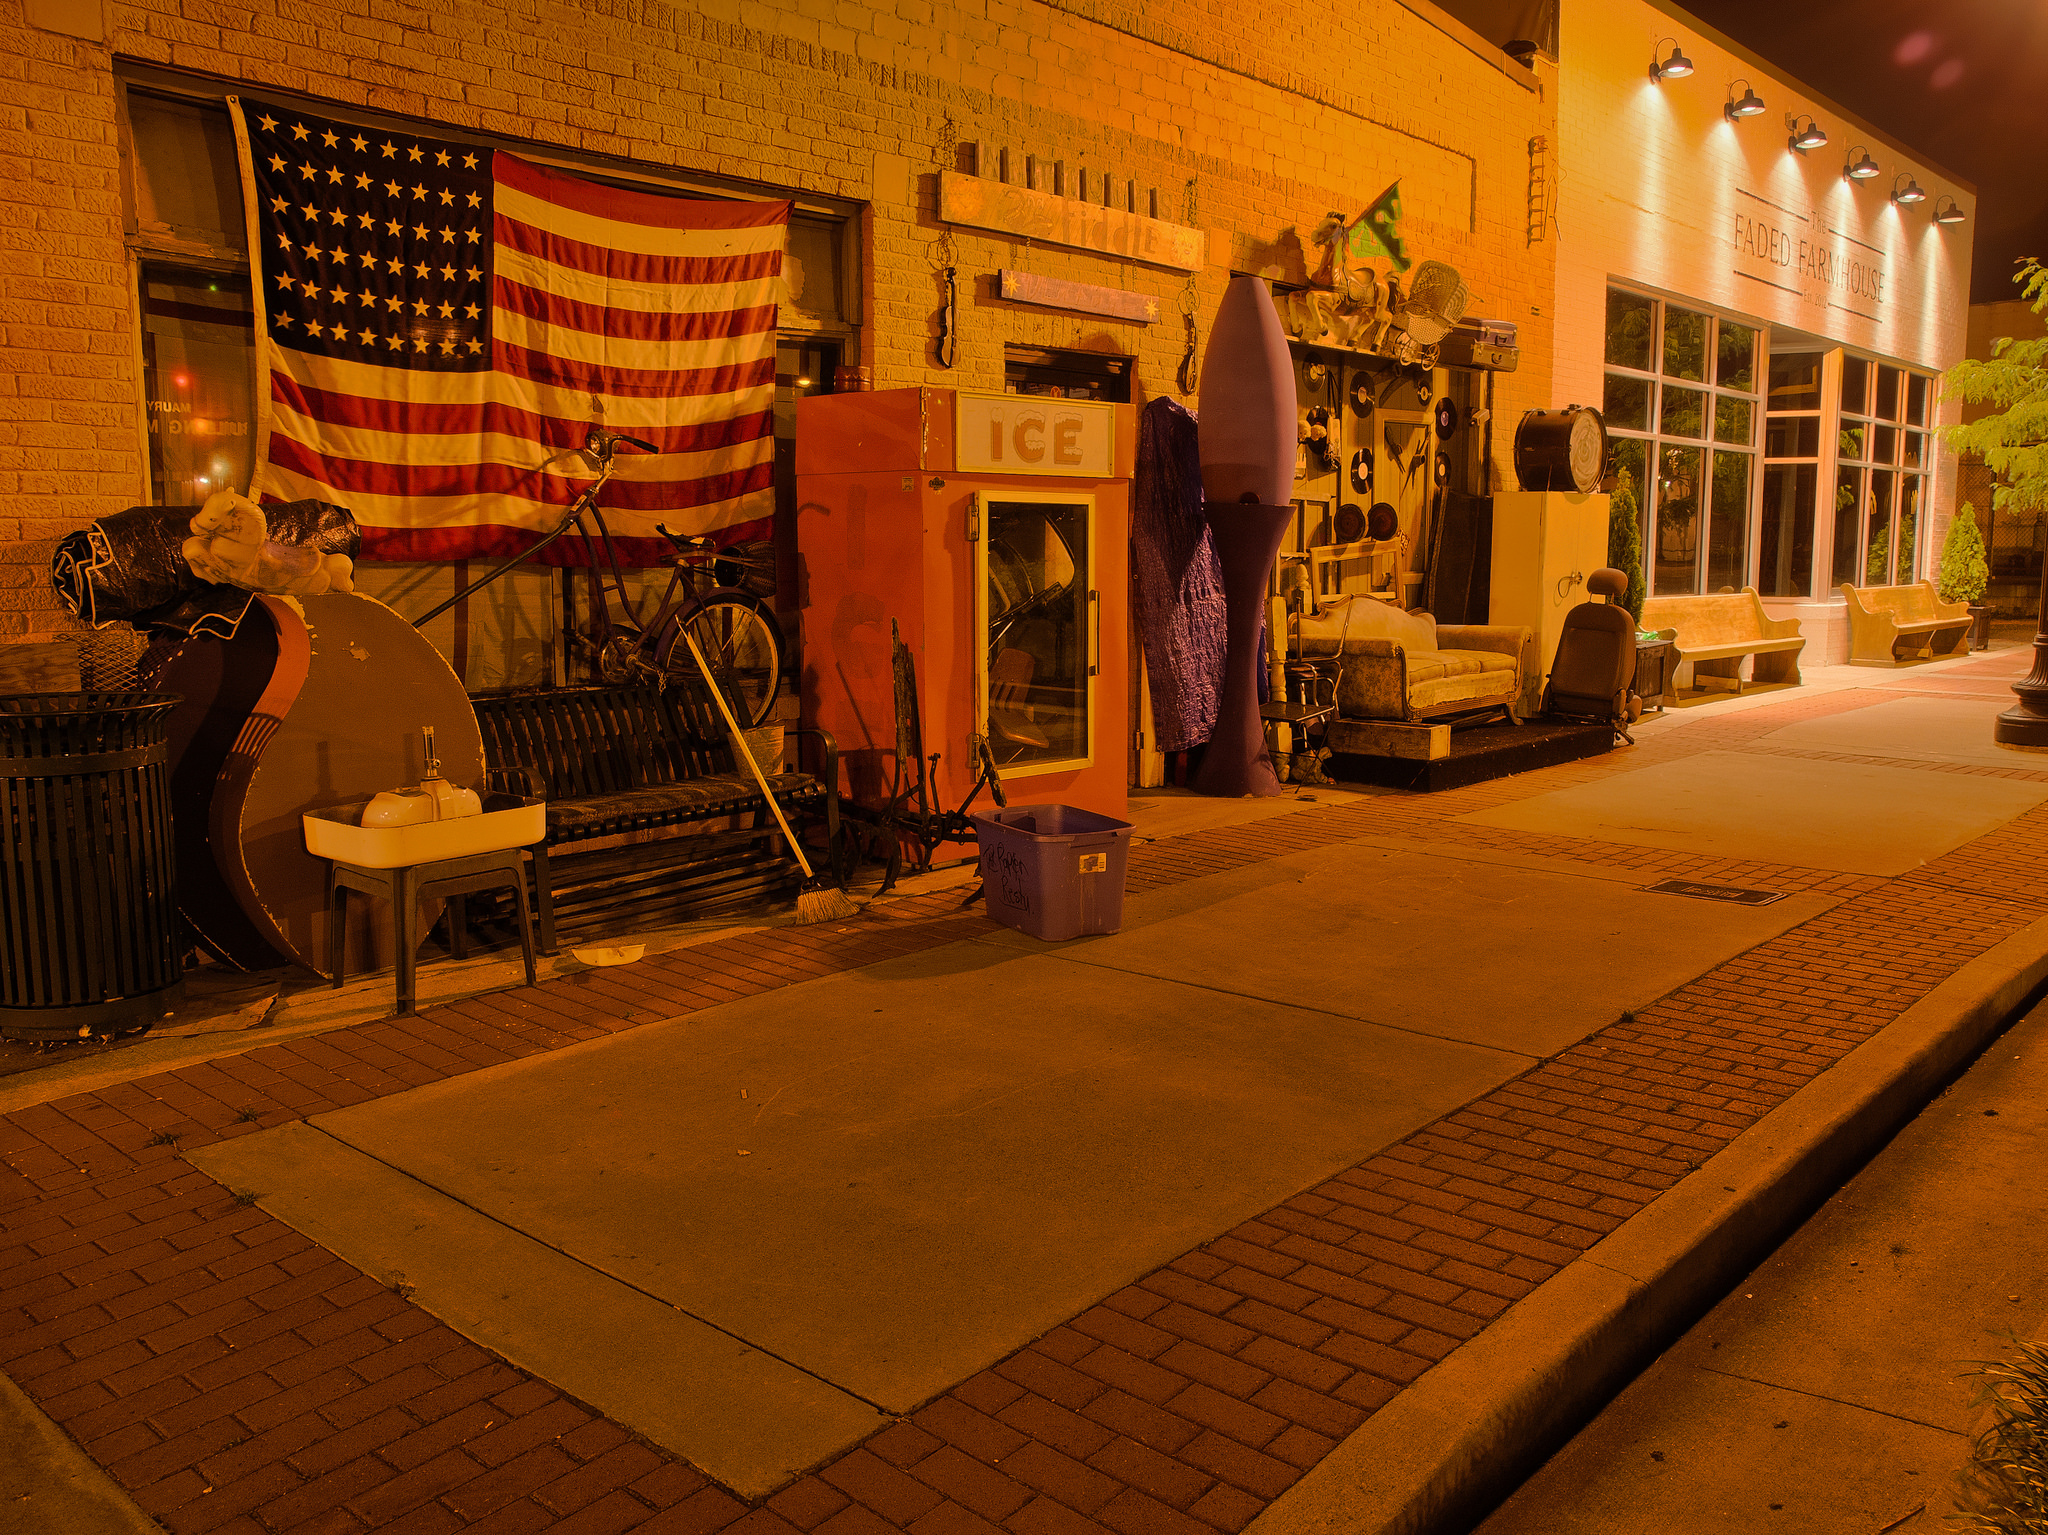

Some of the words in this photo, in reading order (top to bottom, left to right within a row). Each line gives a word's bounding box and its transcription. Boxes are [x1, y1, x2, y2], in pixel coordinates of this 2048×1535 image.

[1811, 210, 1827, 235] The
[1734, 213, 1791, 267] FADED
[1798, 240, 1886, 304] FARMHOUSE
[990, 406, 1084, 466] ICE
